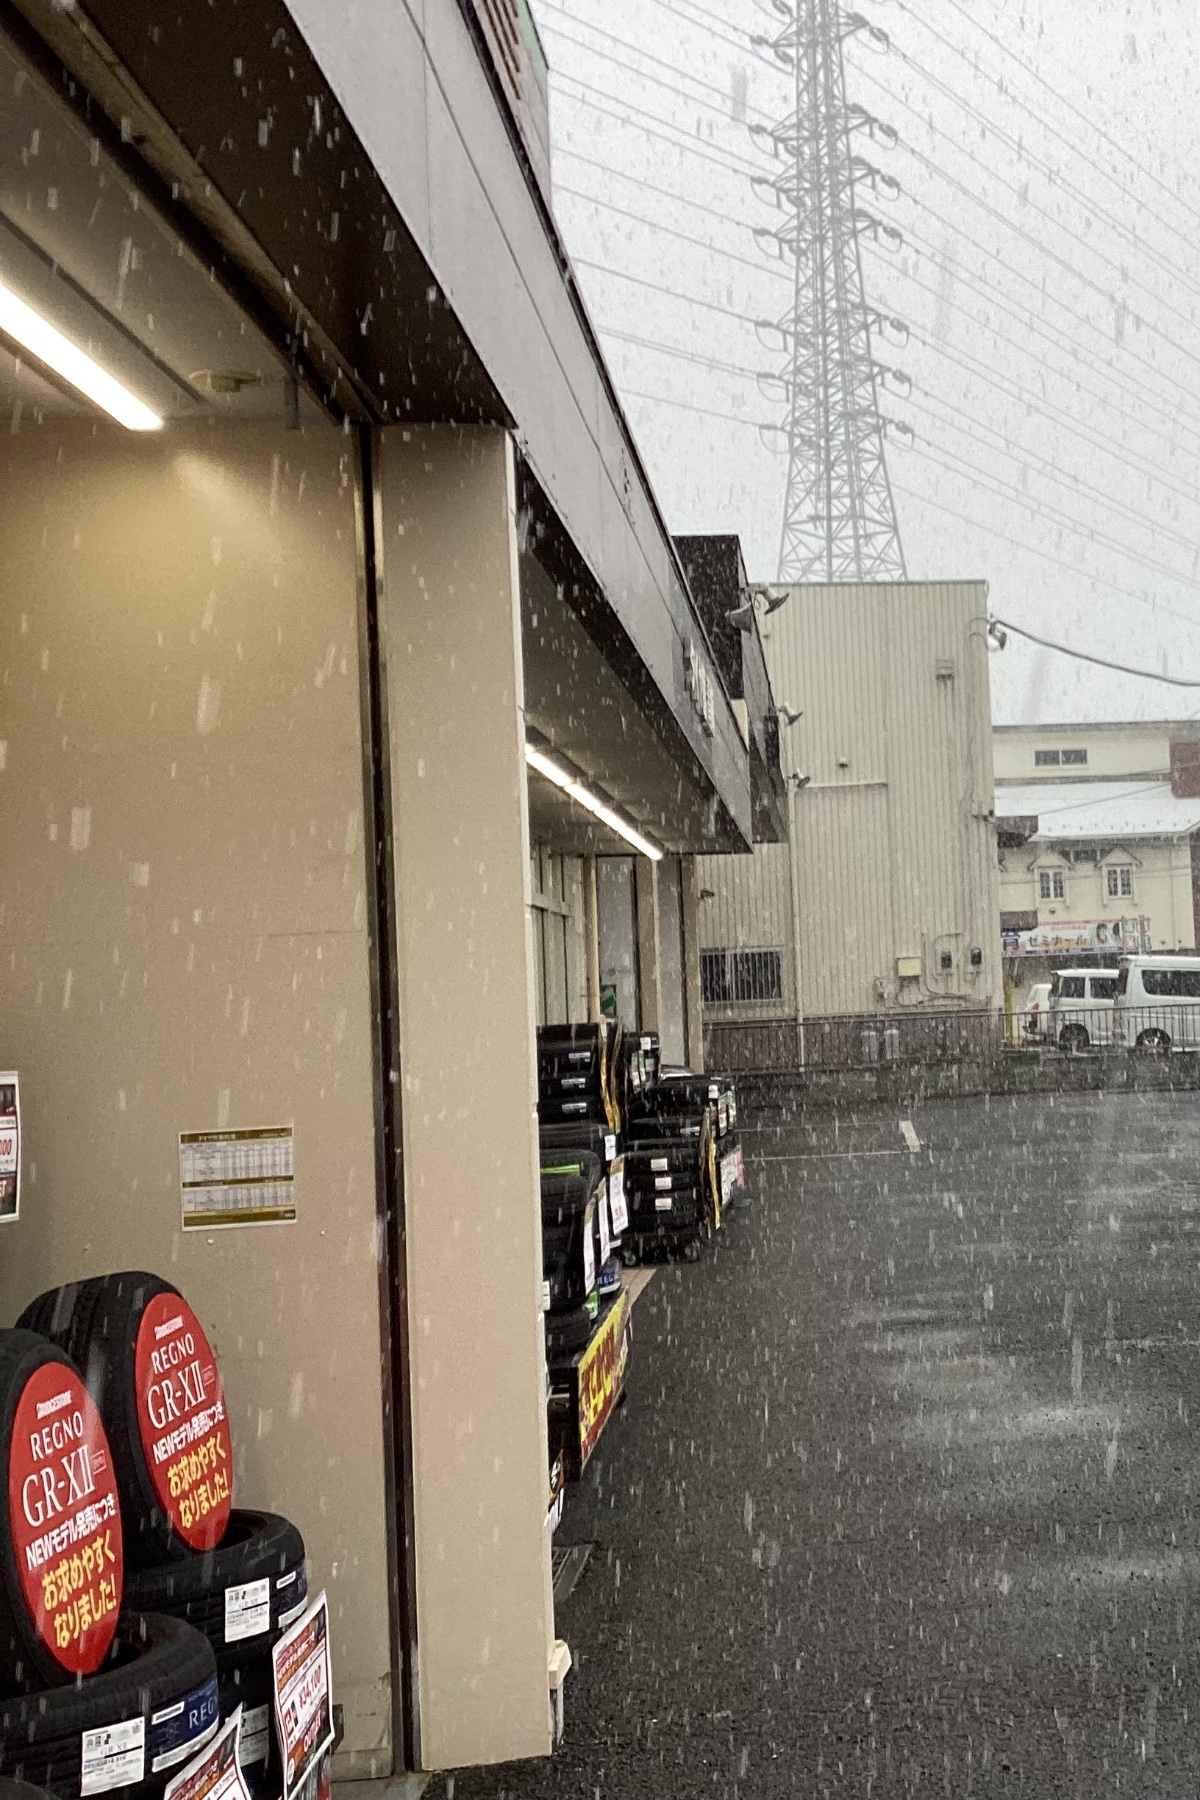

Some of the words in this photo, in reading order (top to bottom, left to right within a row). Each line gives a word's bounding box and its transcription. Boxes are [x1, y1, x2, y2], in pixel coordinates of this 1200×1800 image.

[151, 1332, 195, 1374] REGNO
[30, 1411, 83, 1461] REGNO
[152, 1401, 225, 1465] NEWモデル発売につき
[167, 1431, 226, 1498] お求めやすく
[178, 1468, 229, 1529] なりました!
[25, 1492, 116, 1572] NEWモデル発売につき
[42, 1529, 116, 1611] お求めやすく
[54, 1573, 117, 1649] なりました!
